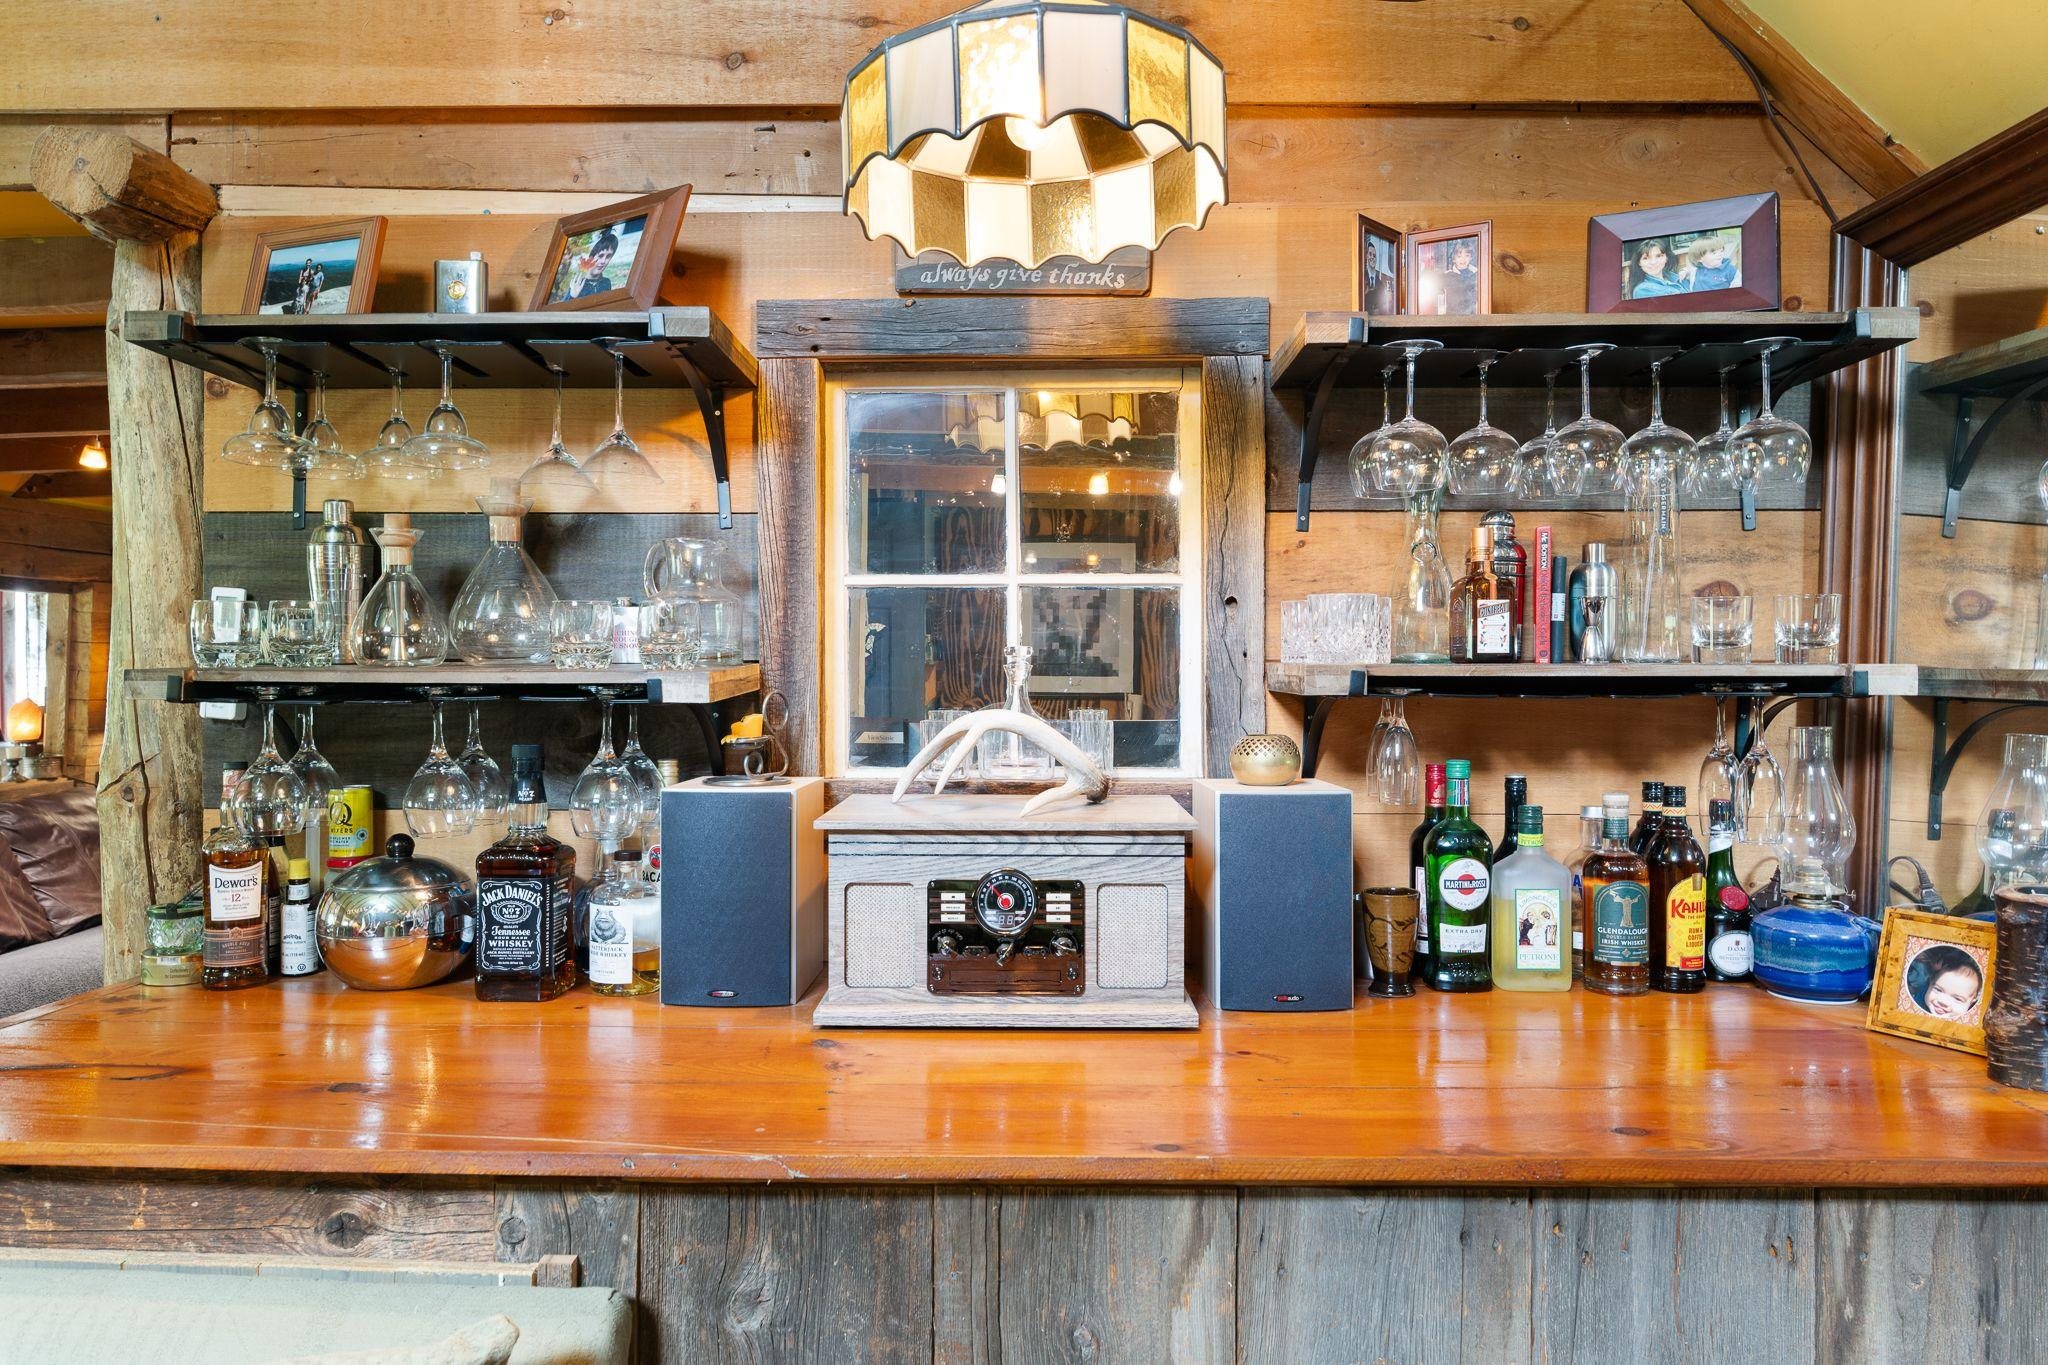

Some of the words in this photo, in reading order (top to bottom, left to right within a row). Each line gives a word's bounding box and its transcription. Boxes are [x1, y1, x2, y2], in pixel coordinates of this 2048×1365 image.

[920, 263, 991, 290] always
[989, 264, 1043, 290] give
[1049, 262, 1126, 289] thanks
[214, 875, 258, 889] Dewar's
[231, 893, 241, 903] 12
[481, 887, 506, 907] JACK
[504, 884, 543, 907] DANIEL'S
[491, 925, 531, 936] Tennessee
[488, 939, 534, 948] WHISKEY
[1519, 953, 1559, 961] PETRONE
